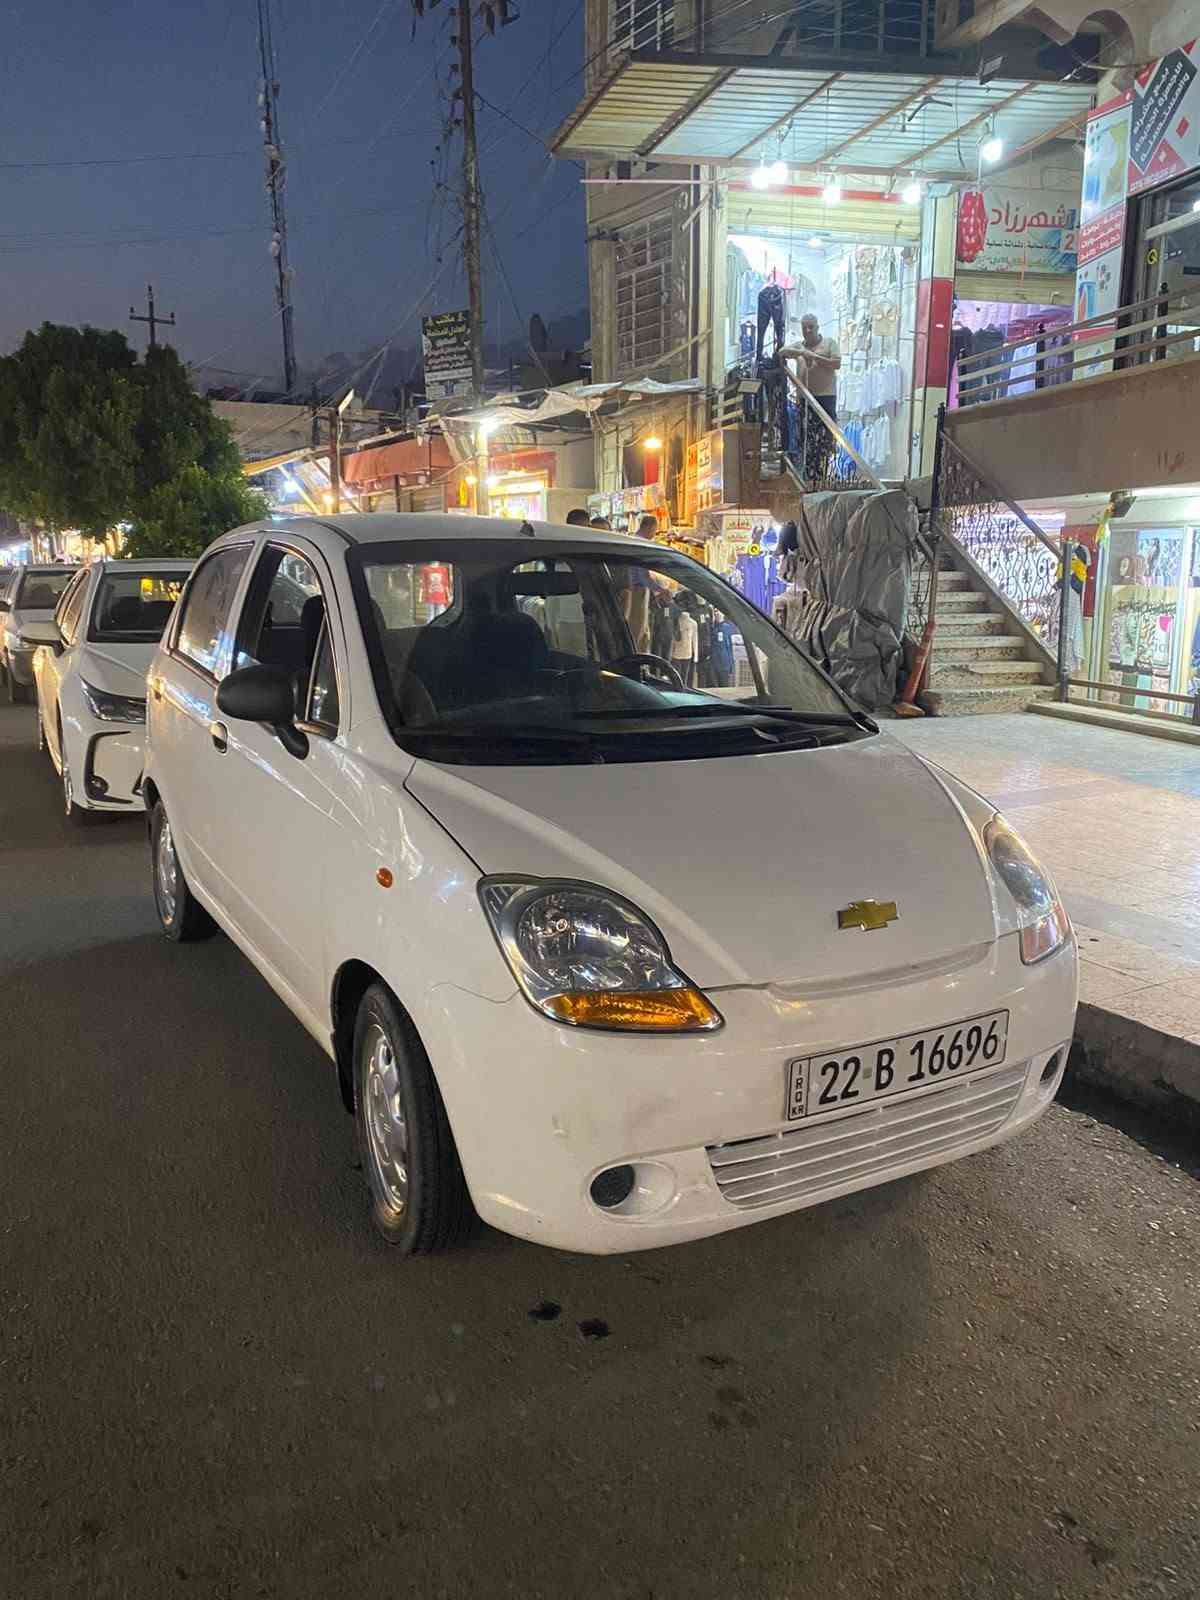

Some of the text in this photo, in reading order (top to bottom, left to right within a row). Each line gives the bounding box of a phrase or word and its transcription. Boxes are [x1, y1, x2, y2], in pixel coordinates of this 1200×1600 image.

[990, 200, 1065, 232] شهرزاد
[1064, 233, 1075, 251] 2
[819, 1020, 998, 1105] 22 B 16696
